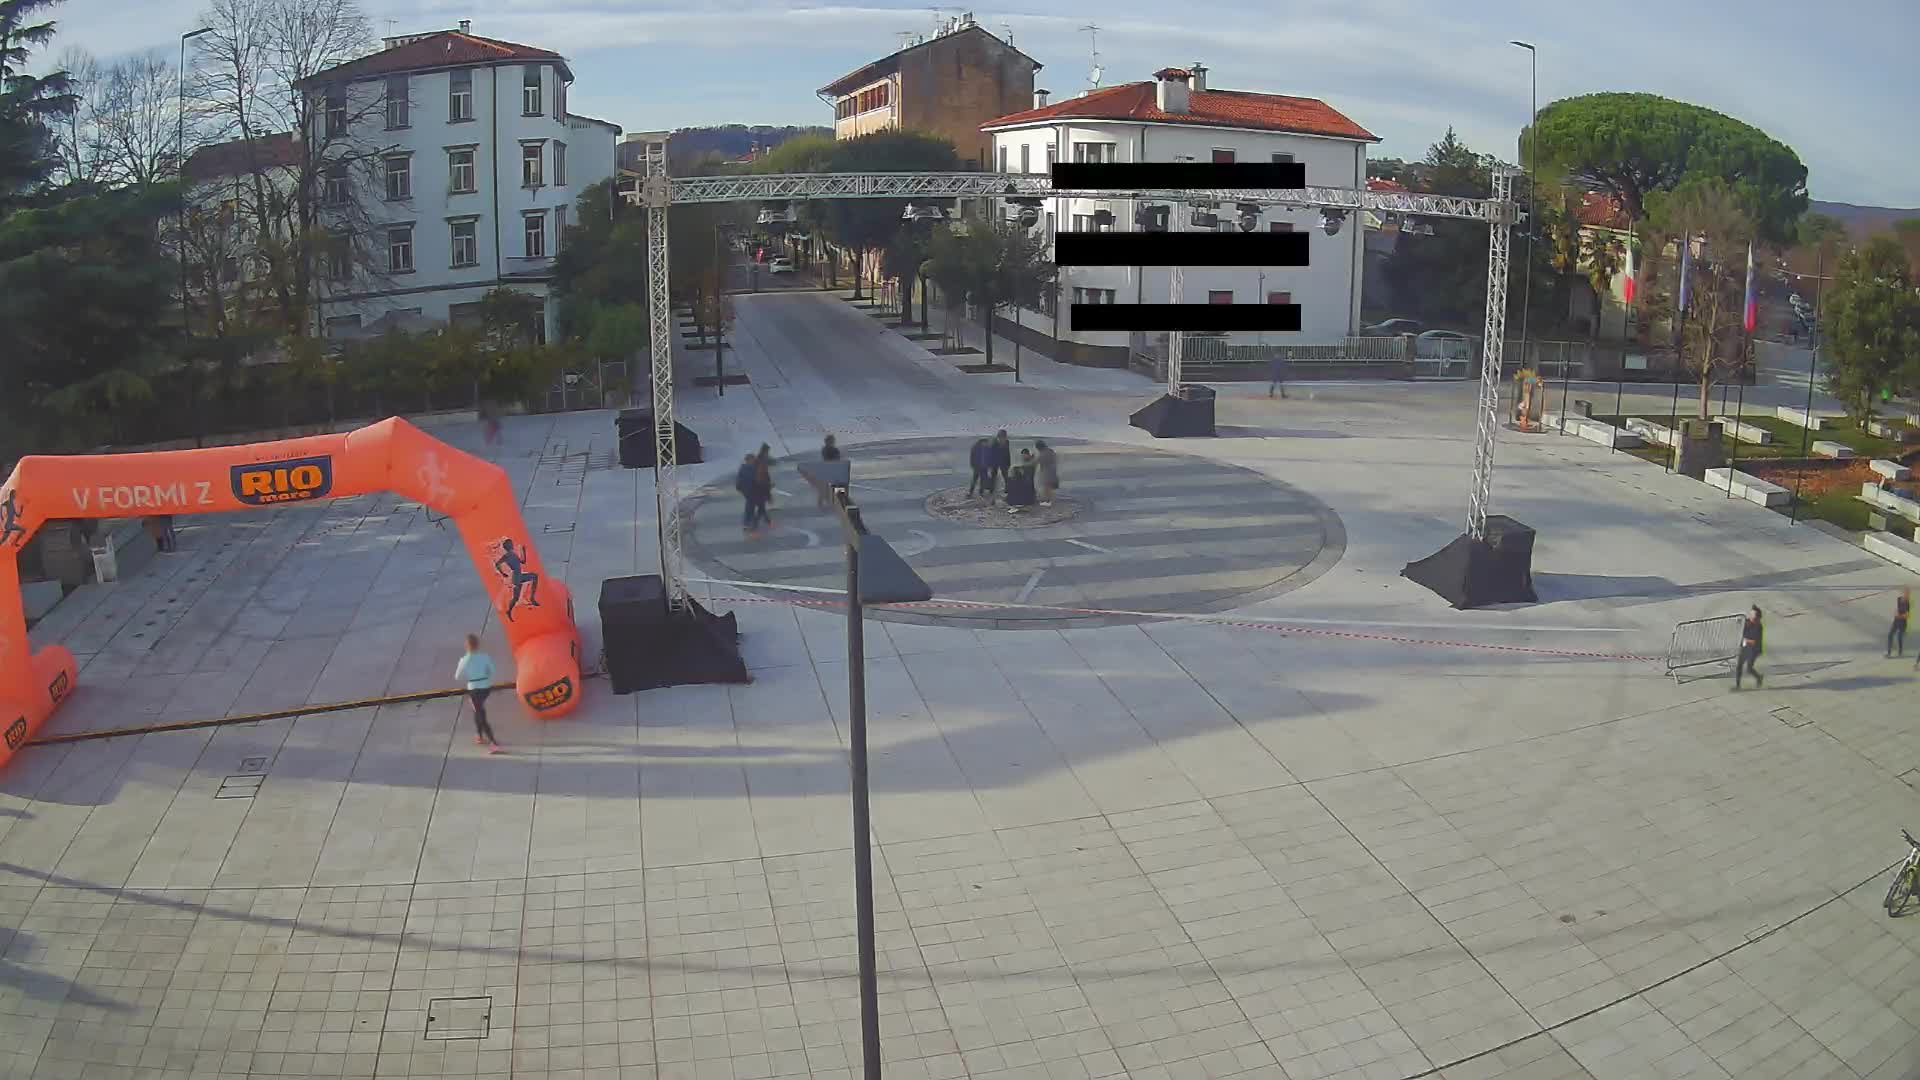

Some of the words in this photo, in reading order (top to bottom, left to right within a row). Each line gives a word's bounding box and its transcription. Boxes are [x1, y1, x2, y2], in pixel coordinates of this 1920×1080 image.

[240, 465, 323, 496] RIO
[72, 487, 90, 511] V
[98, 482, 187, 511] FORMI
[194, 481, 214, 505] Z
[529, 682, 569, 705] RIO
